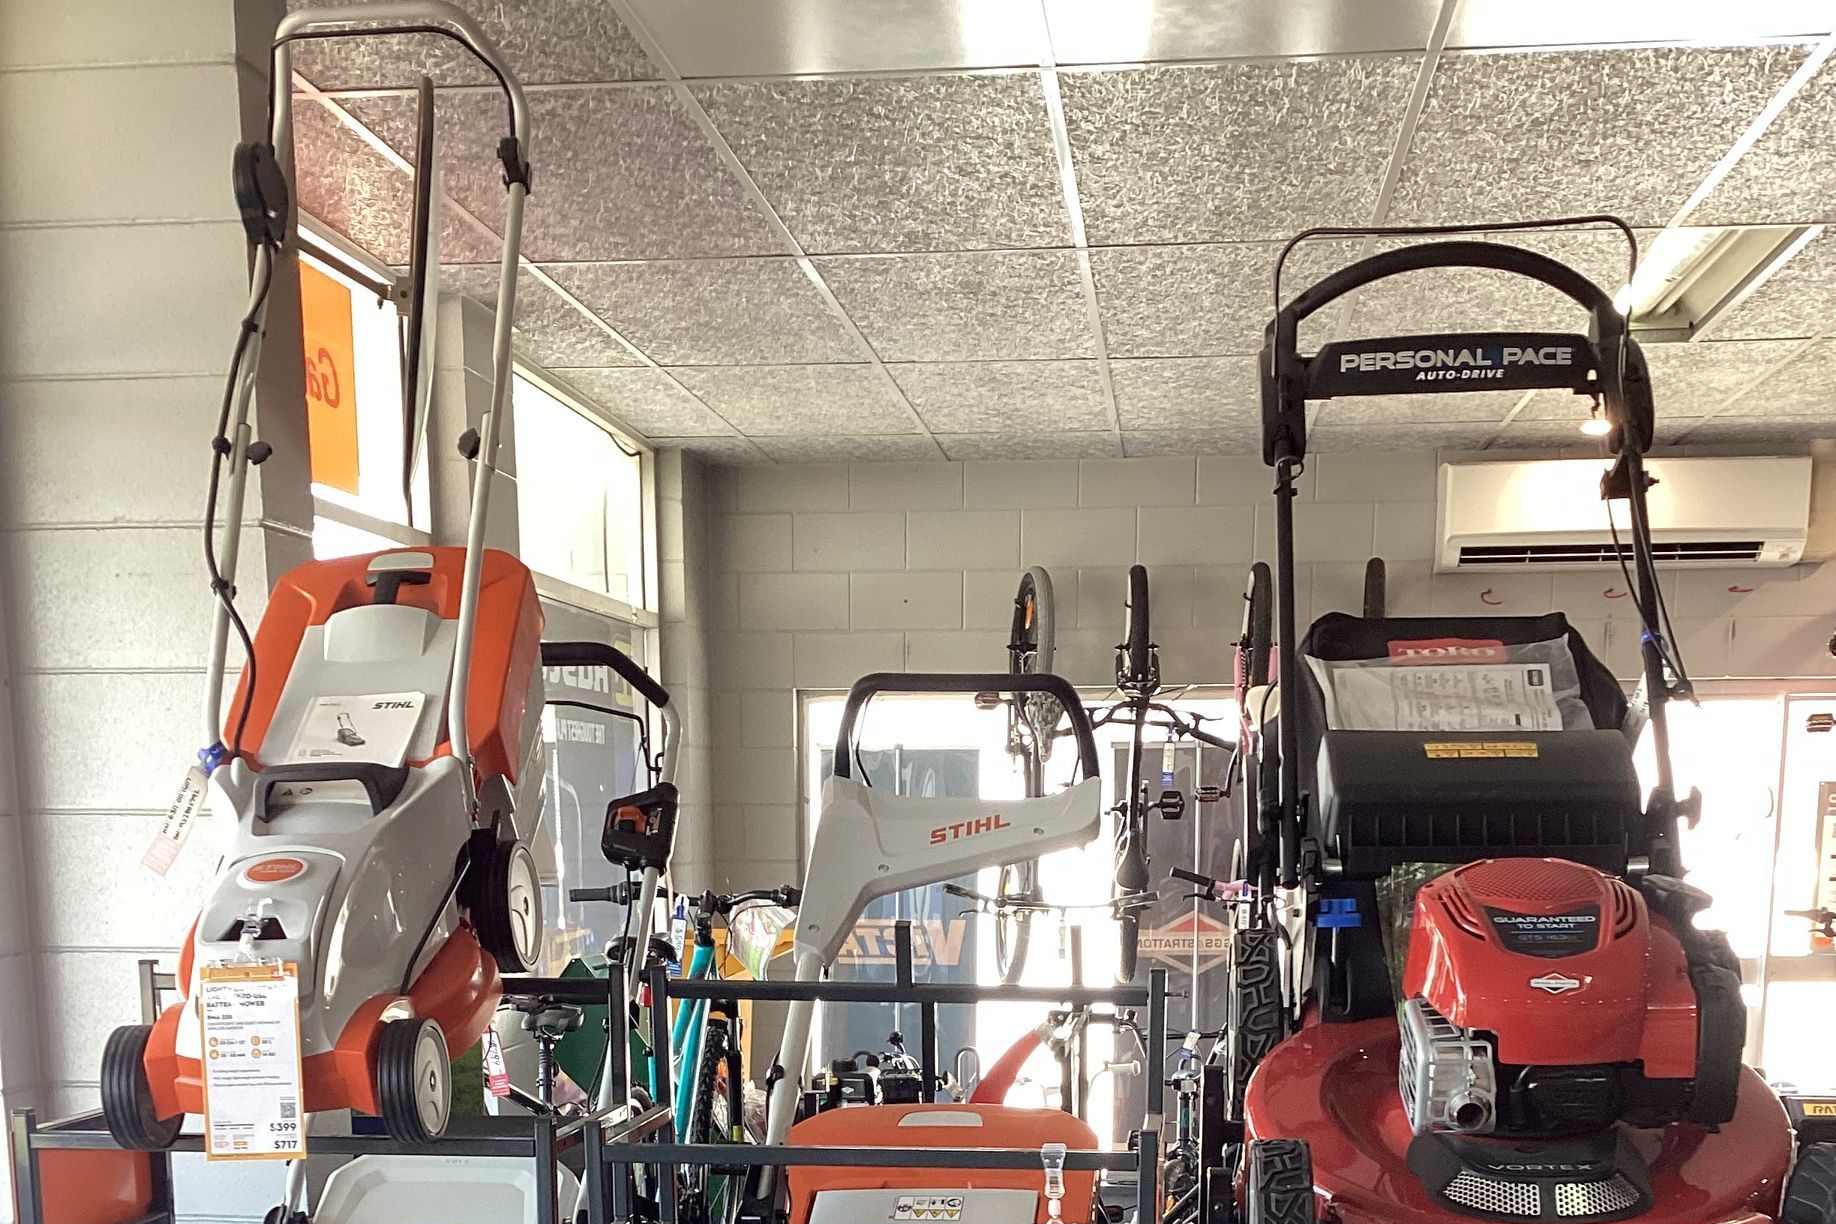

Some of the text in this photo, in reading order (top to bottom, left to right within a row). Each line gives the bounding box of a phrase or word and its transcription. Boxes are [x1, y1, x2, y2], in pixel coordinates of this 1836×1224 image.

[1339, 347, 1572, 373] PERSONAL PACE
[1415, 369, 1505, 381] AUTO-DRIVE
[372, 701, 415, 710] STIHL
[930, 814, 1011, 845] STIHL
[1493, 915, 1597, 924] GUARANTEED
[269, 1122, 297, 1131] $399
[273, 1140, 298, 1149] $717
